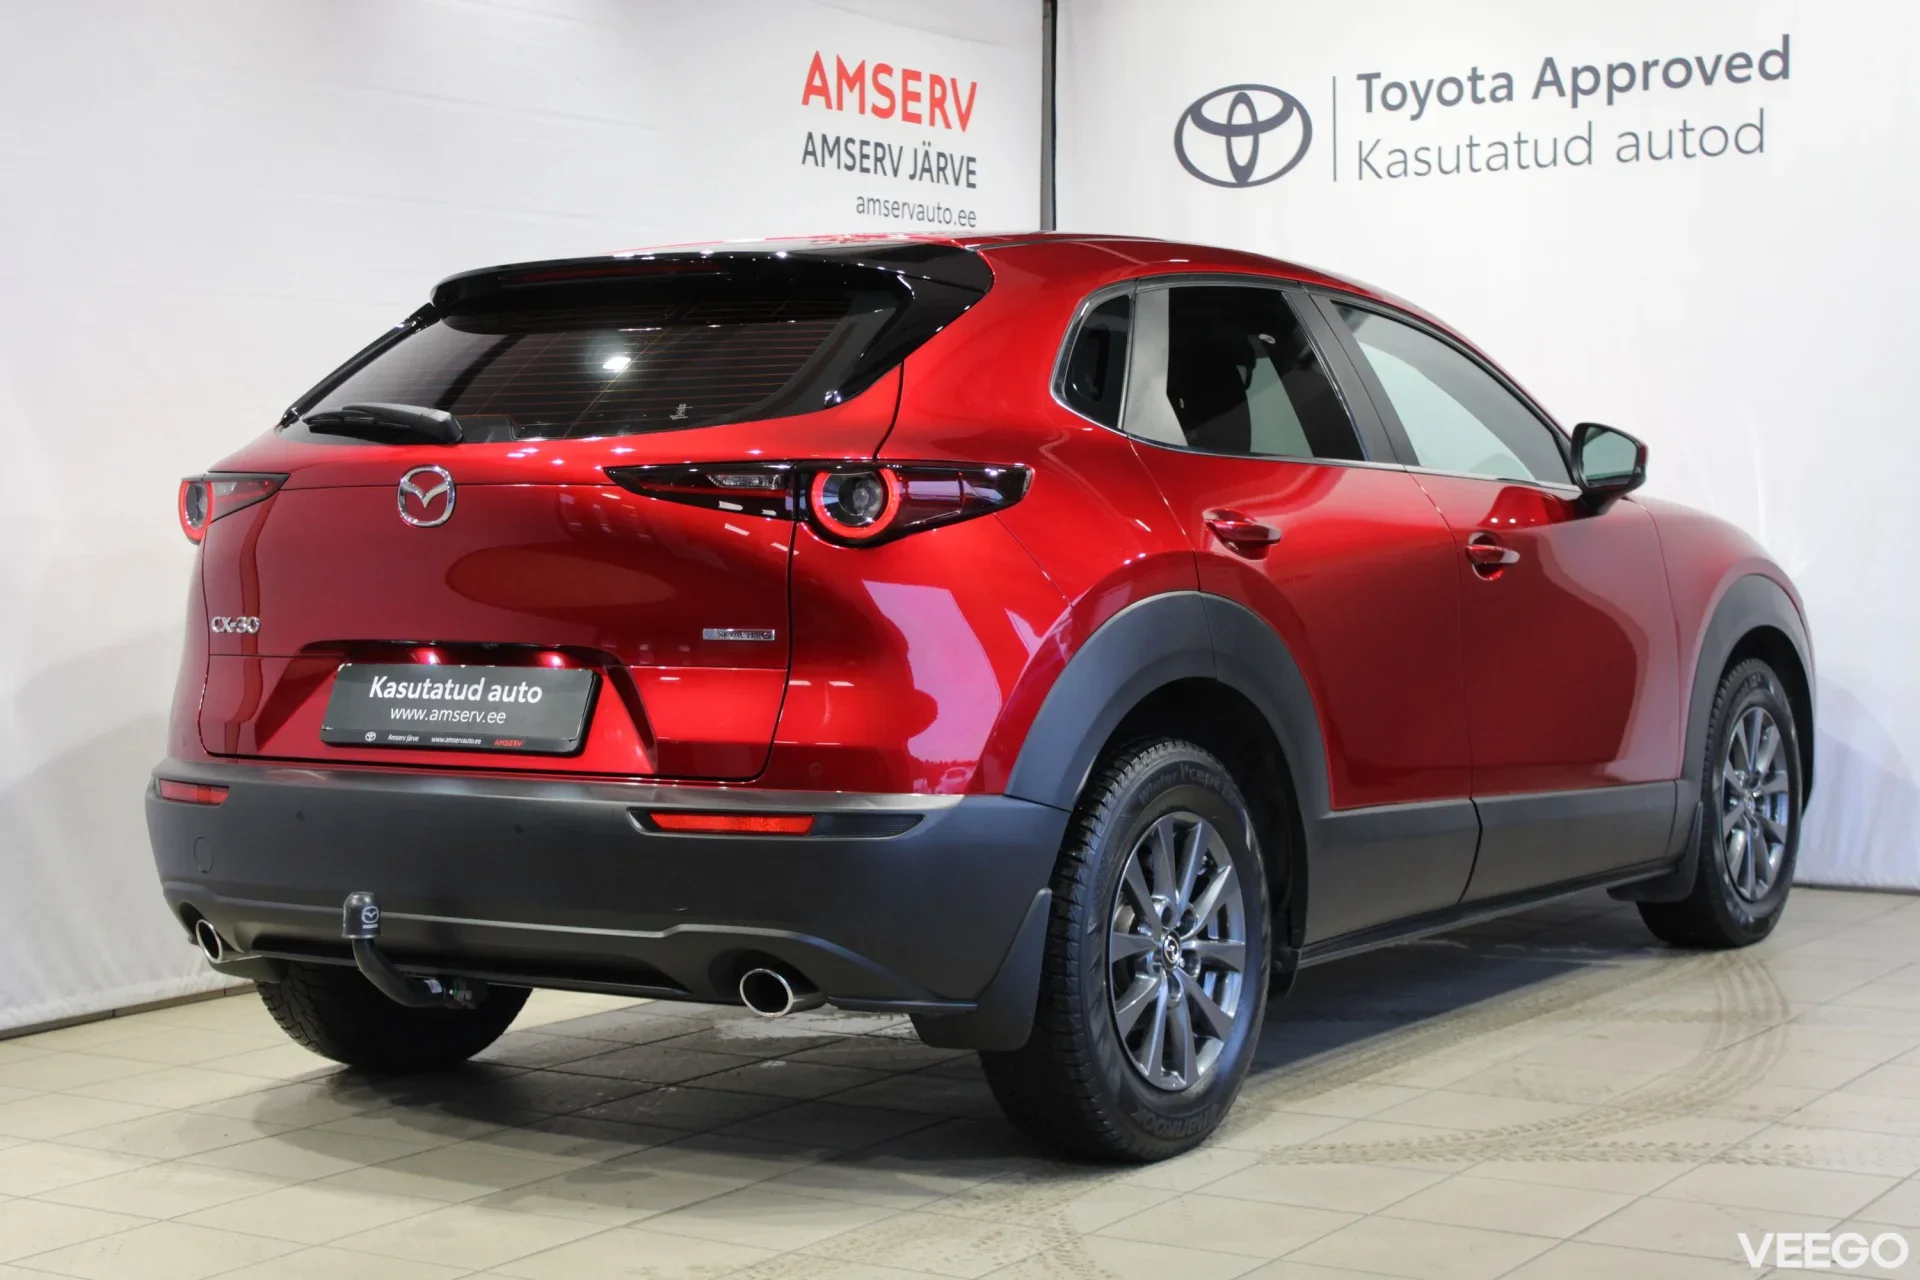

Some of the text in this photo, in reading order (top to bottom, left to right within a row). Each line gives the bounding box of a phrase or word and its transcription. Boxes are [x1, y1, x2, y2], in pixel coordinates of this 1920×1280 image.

[802, 51, 977, 133] AMSERV
[1357, 34, 1790, 121] Toyota Approved
[802, 131, 977, 189] AMSERV JÄRVE
[1357, 107, 1765, 181] Kasutatud autod
[856, 196, 977, 228] amservauto.ee
[211, 616, 260, 634] CX-30
[369, 676, 542, 704] Kasutatud auto
[390, 706, 506, 724] www.amserv.ee
[494, 739, 523, 747] AMSERV
